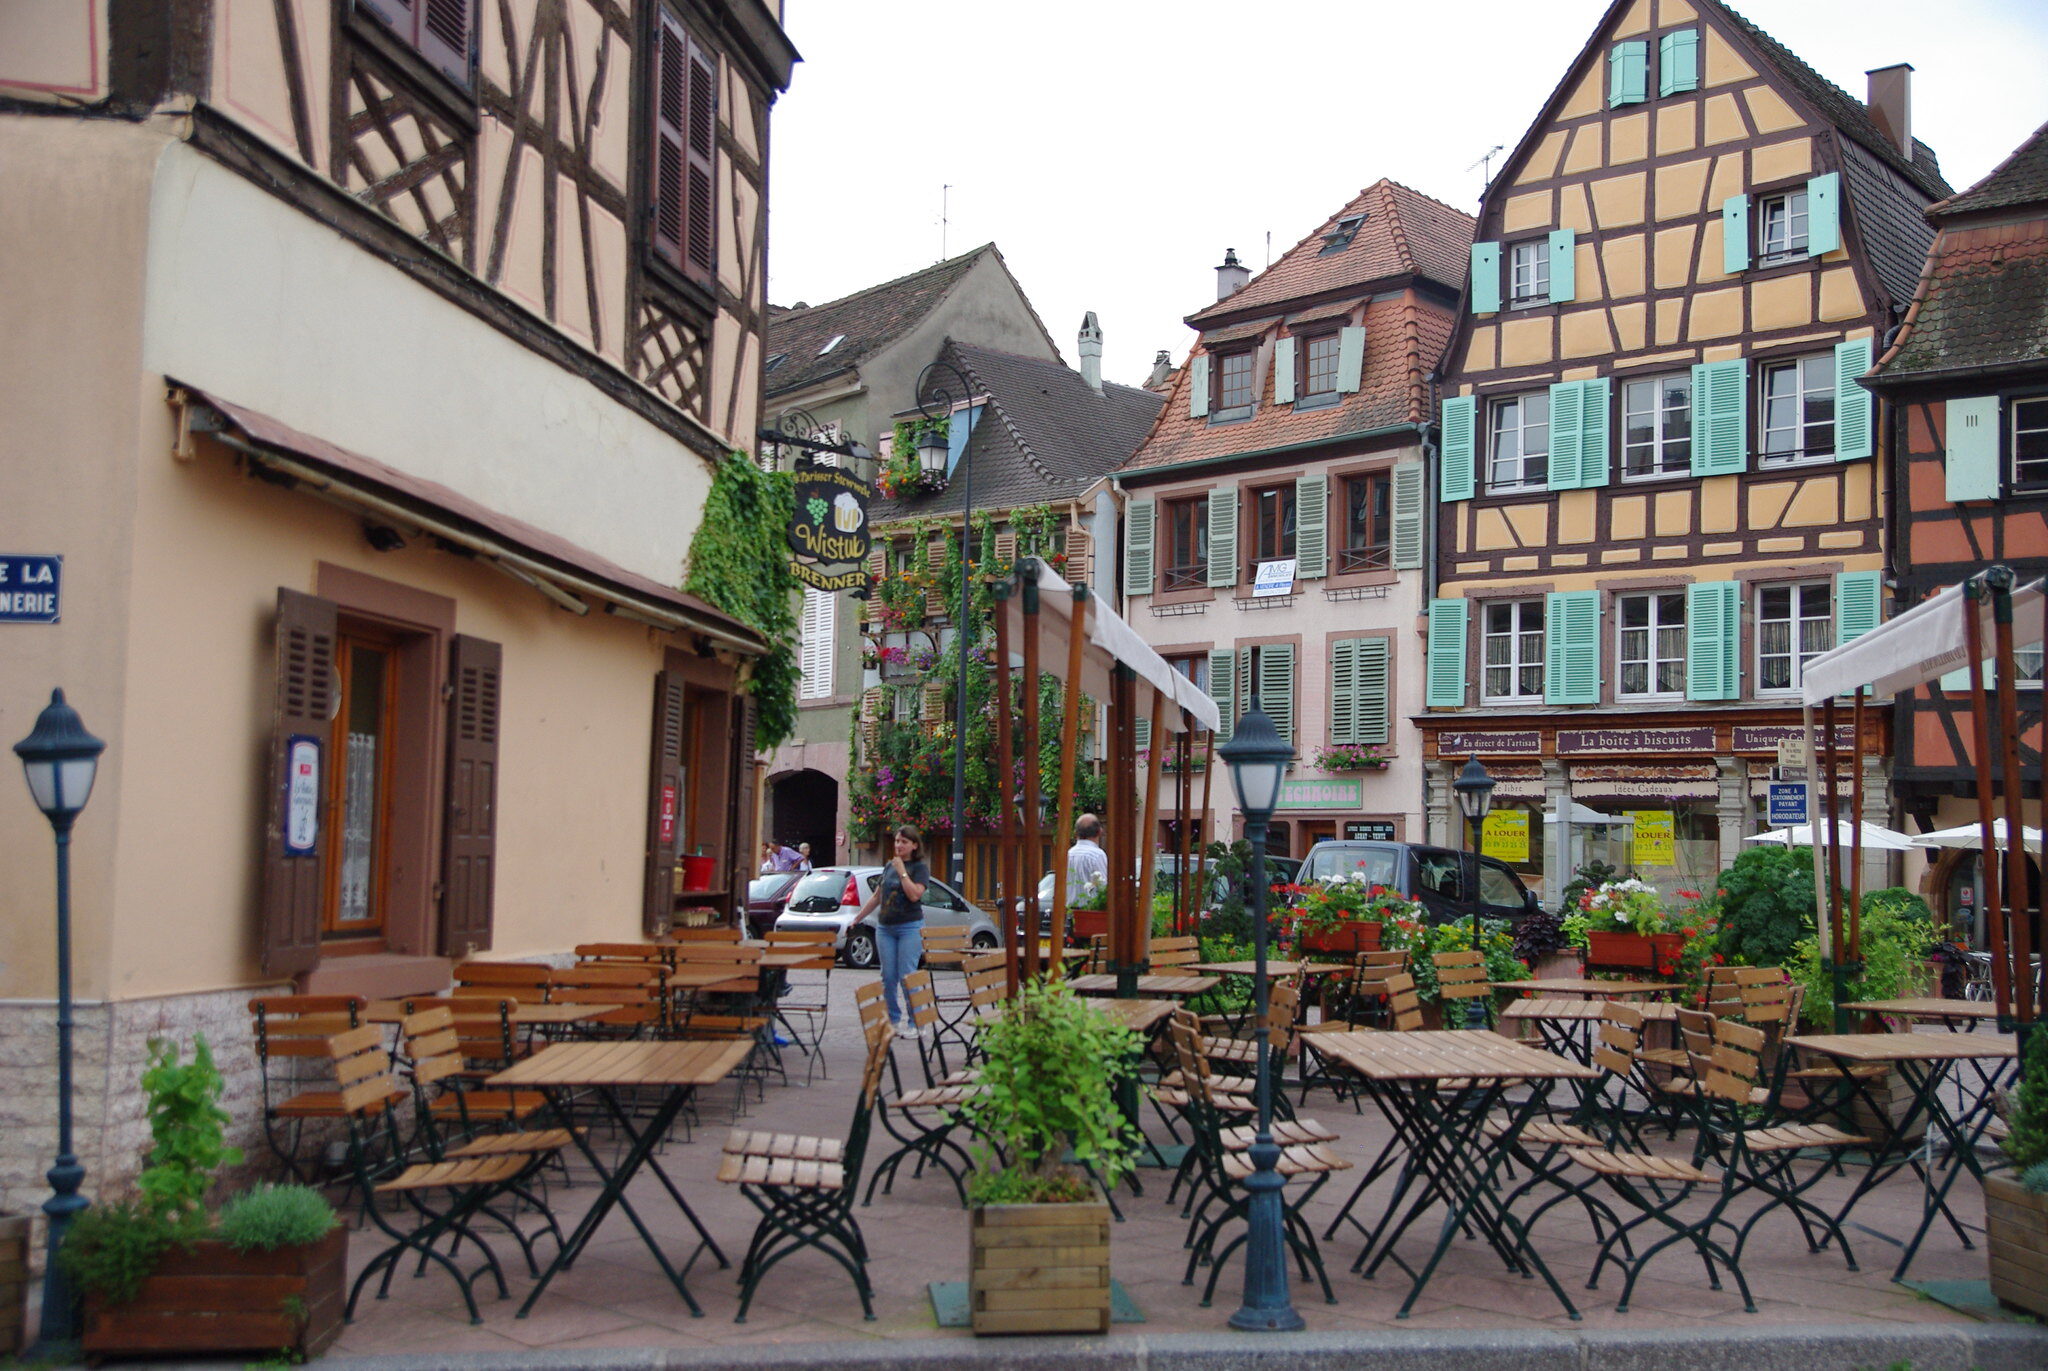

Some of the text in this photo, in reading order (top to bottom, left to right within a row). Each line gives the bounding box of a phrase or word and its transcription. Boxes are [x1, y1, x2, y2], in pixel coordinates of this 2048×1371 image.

[795, 524, 865, 560] Wistub
[22, 563, 54, 584] LA
[789, 561, 866, 590] BRENNER
[1463, 738, 1536, 748] En direct de l'artisan
[1581, 733, 1691, 747] La boîte à biscuits
[1745, 734, 1777, 746] Unique
[1789, 732, 1824, 742] Colar
[1504, 784, 1522, 792] libre
[1614, 784, 1673, 793] Idées Cadeaux
[1778, 787, 1791, 795] ZONE
[1771, 812, 1806, 820] HORODATEUR
